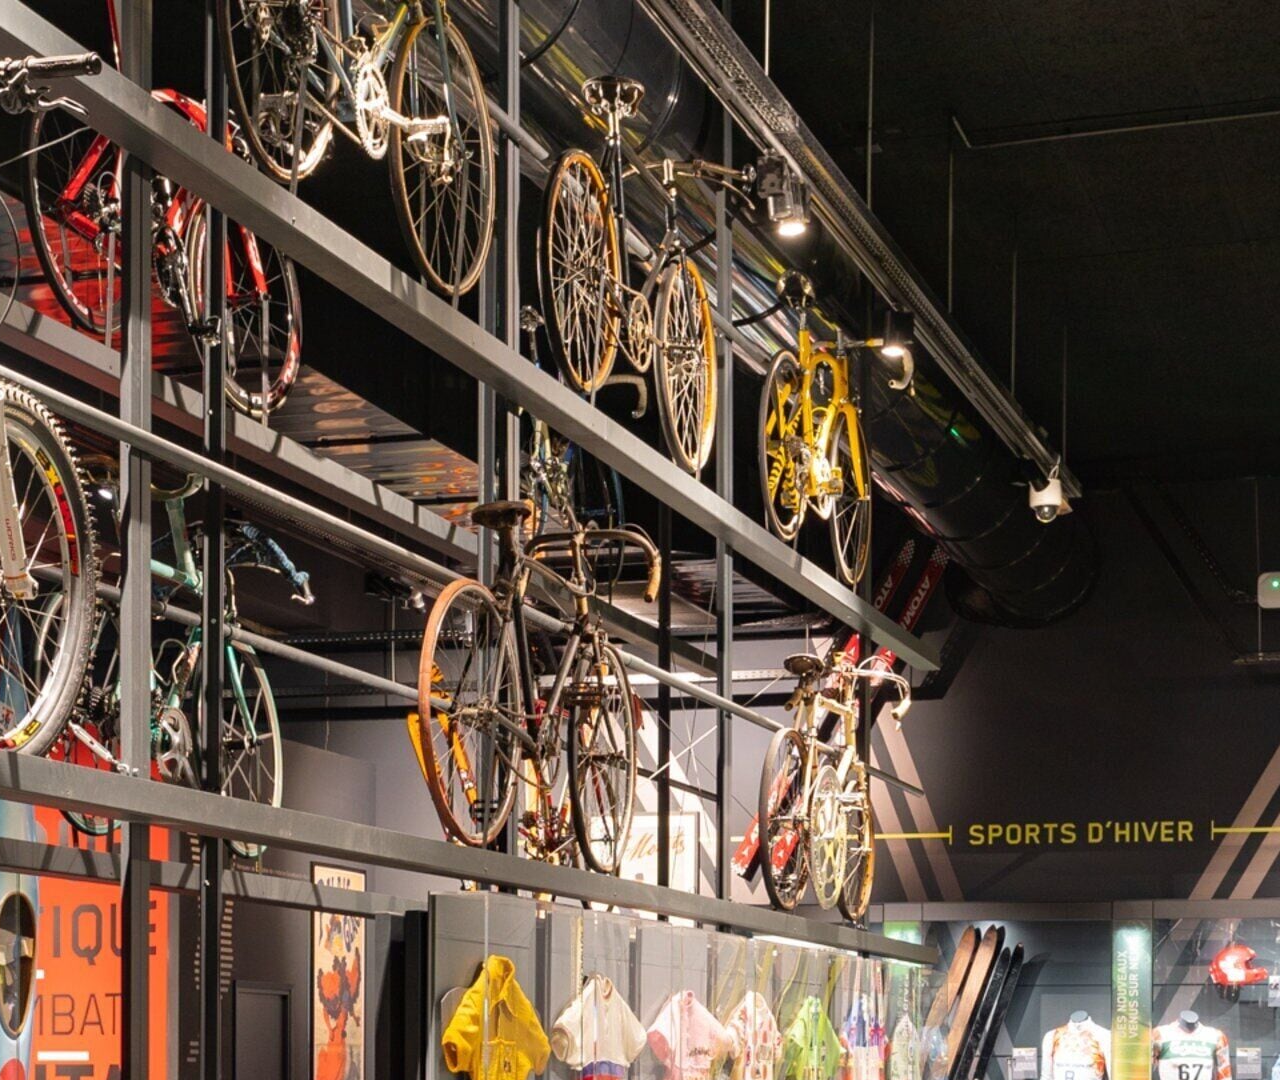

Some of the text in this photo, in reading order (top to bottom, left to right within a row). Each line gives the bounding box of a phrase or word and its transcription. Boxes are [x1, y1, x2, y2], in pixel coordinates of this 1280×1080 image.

[968, 820, 1194, 846] SPORTS D'HIVER
[1117, 950, 1128, 1013] NOUVEAUX
[1128, 973, 1139, 996] SUR
[1128, 1001, 1139, 1039] VENUS
